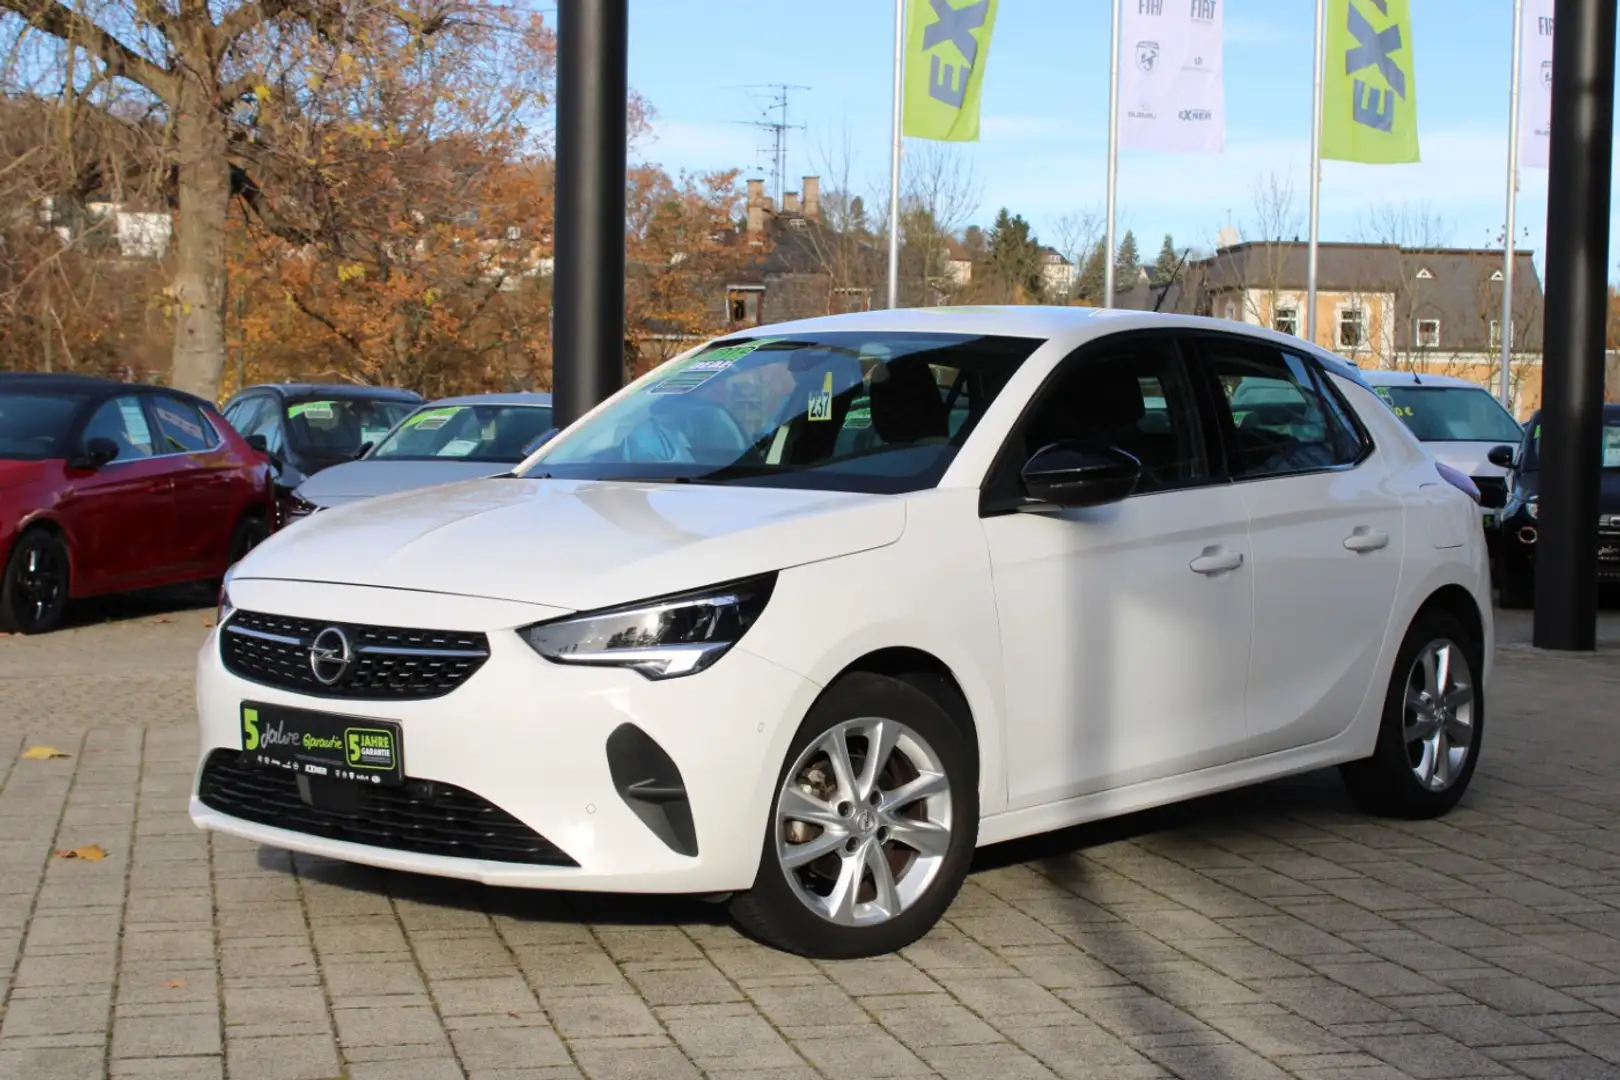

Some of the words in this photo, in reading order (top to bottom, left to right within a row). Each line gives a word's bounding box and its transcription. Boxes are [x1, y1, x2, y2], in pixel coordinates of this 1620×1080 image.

[1190, 0, 1216, 19] FIAT
[243, 707, 260, 751] 5
[348, 734, 361, 762] 5
[361, 734, 390, 748] JAHRE
[361, 747, 391, 757] GARANTIE
